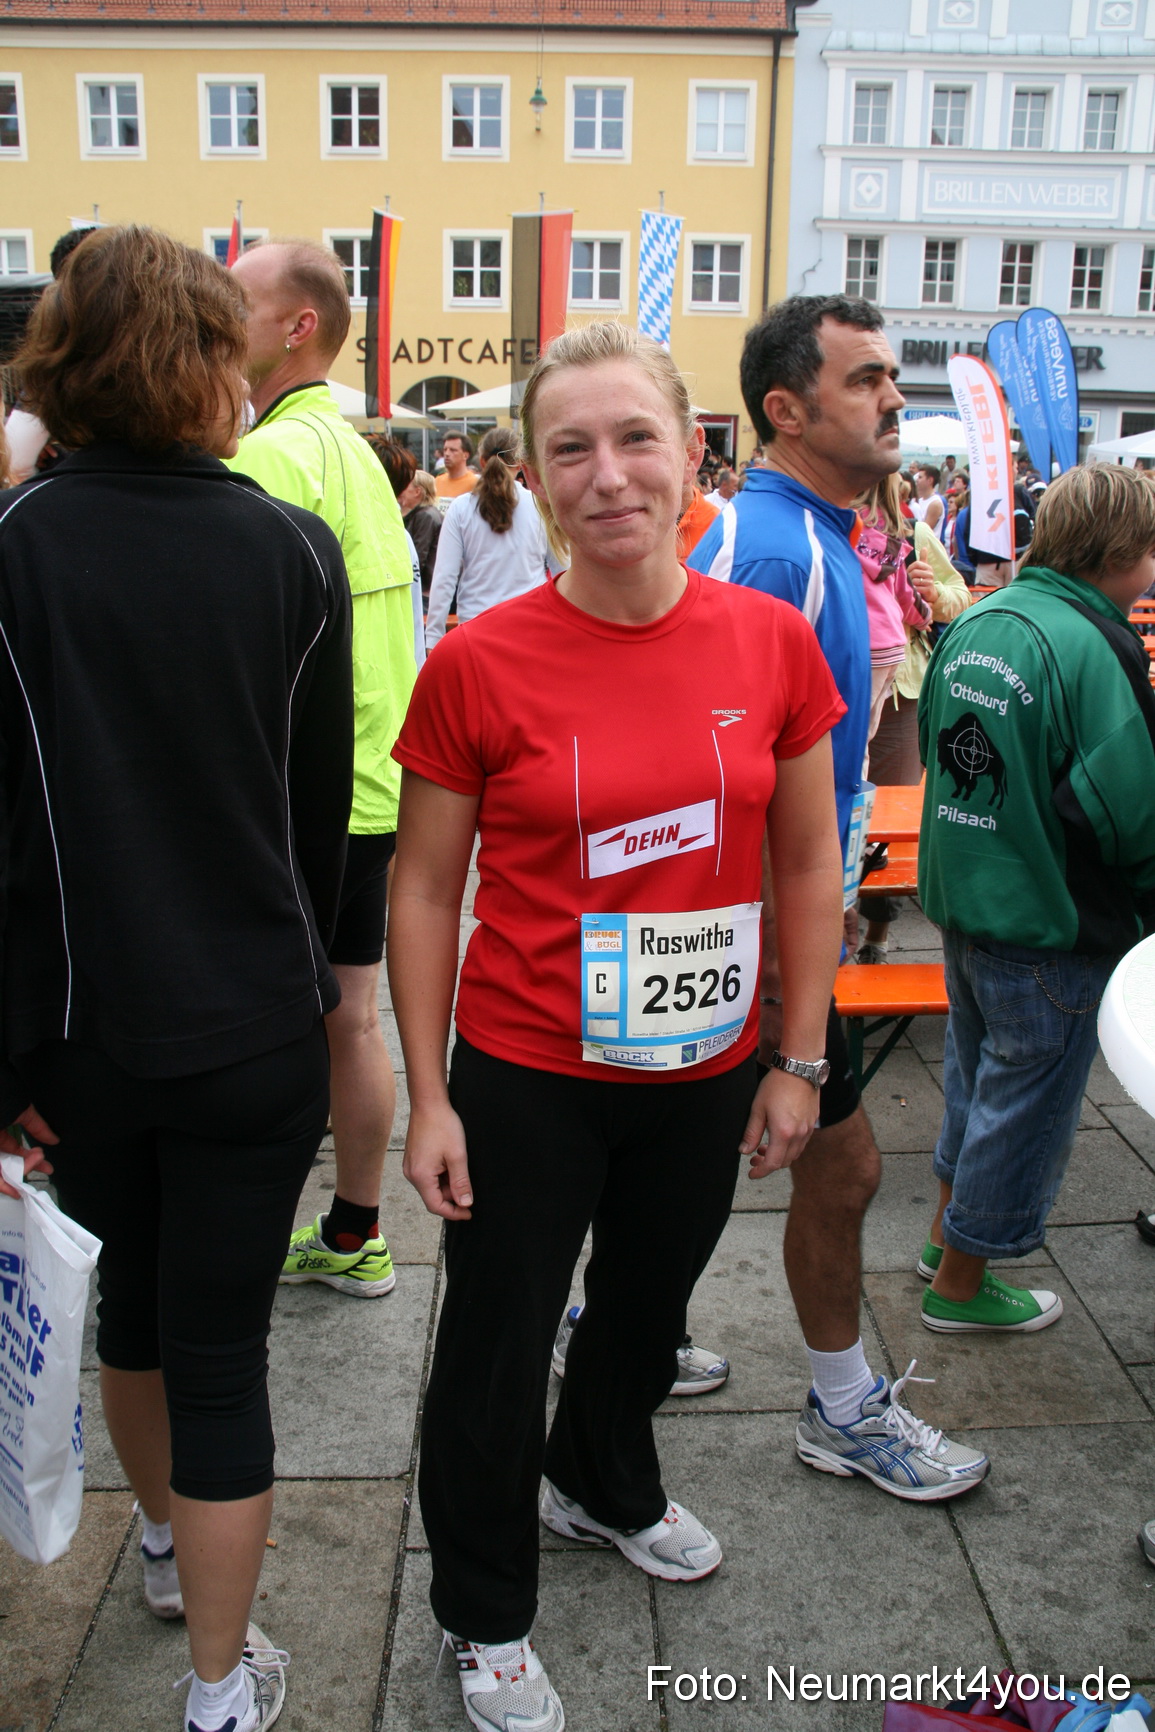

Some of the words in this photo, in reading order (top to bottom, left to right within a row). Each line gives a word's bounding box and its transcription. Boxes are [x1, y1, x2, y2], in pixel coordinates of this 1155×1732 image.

[934, 180, 1023, 204] BRILLEN
[1027, 183, 1109, 208] WEBER
[937, 805, 997, 831] Pilsach
[624, 822, 681, 857] DEHN
[640, 922, 734, 956] Roswitha
[595, 973, 606, 994] C
[642, 963, 742, 1015] 2526
[603, 1050, 655, 1063] BOCK
